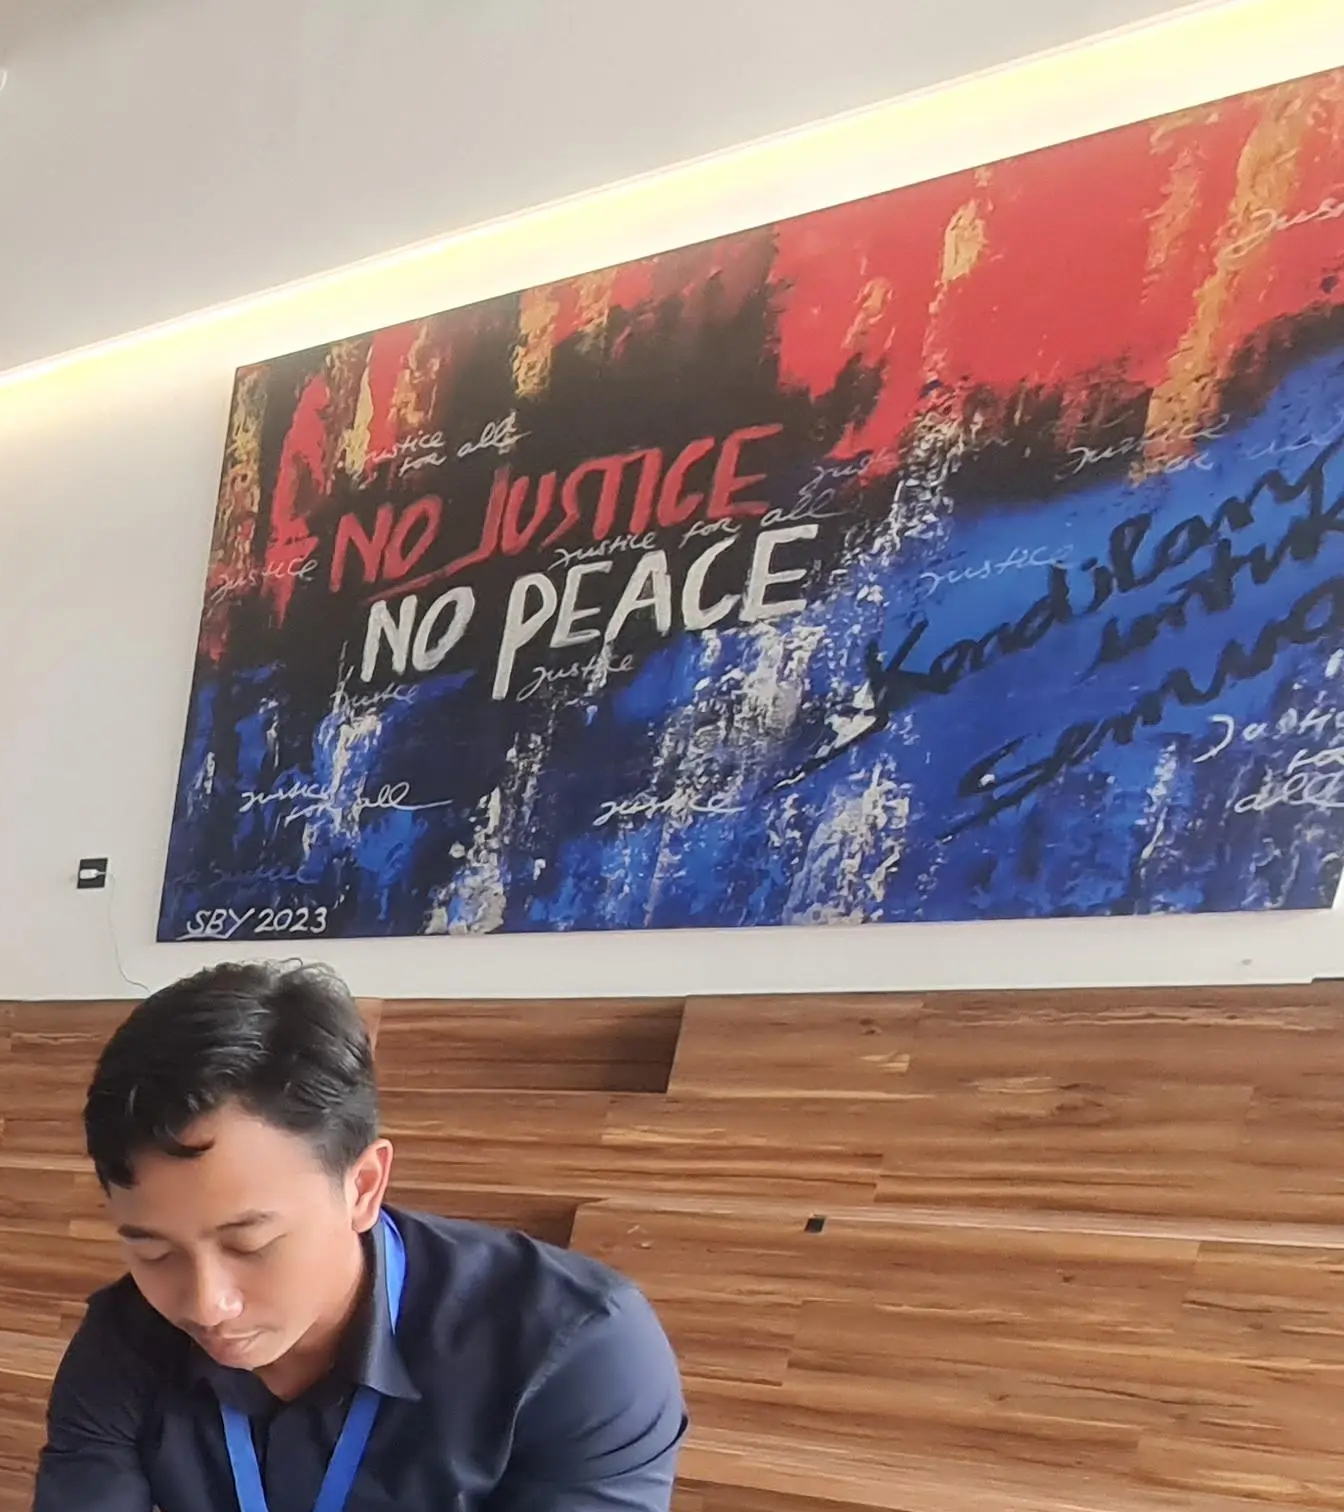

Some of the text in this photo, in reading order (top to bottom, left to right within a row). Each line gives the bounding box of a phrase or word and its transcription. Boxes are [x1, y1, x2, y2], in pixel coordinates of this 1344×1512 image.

[329, 421, 784, 603] NO JUSTICE
[360, 524, 819, 700] NO PEACE
[176, 906, 328, 940] SBY 2023
